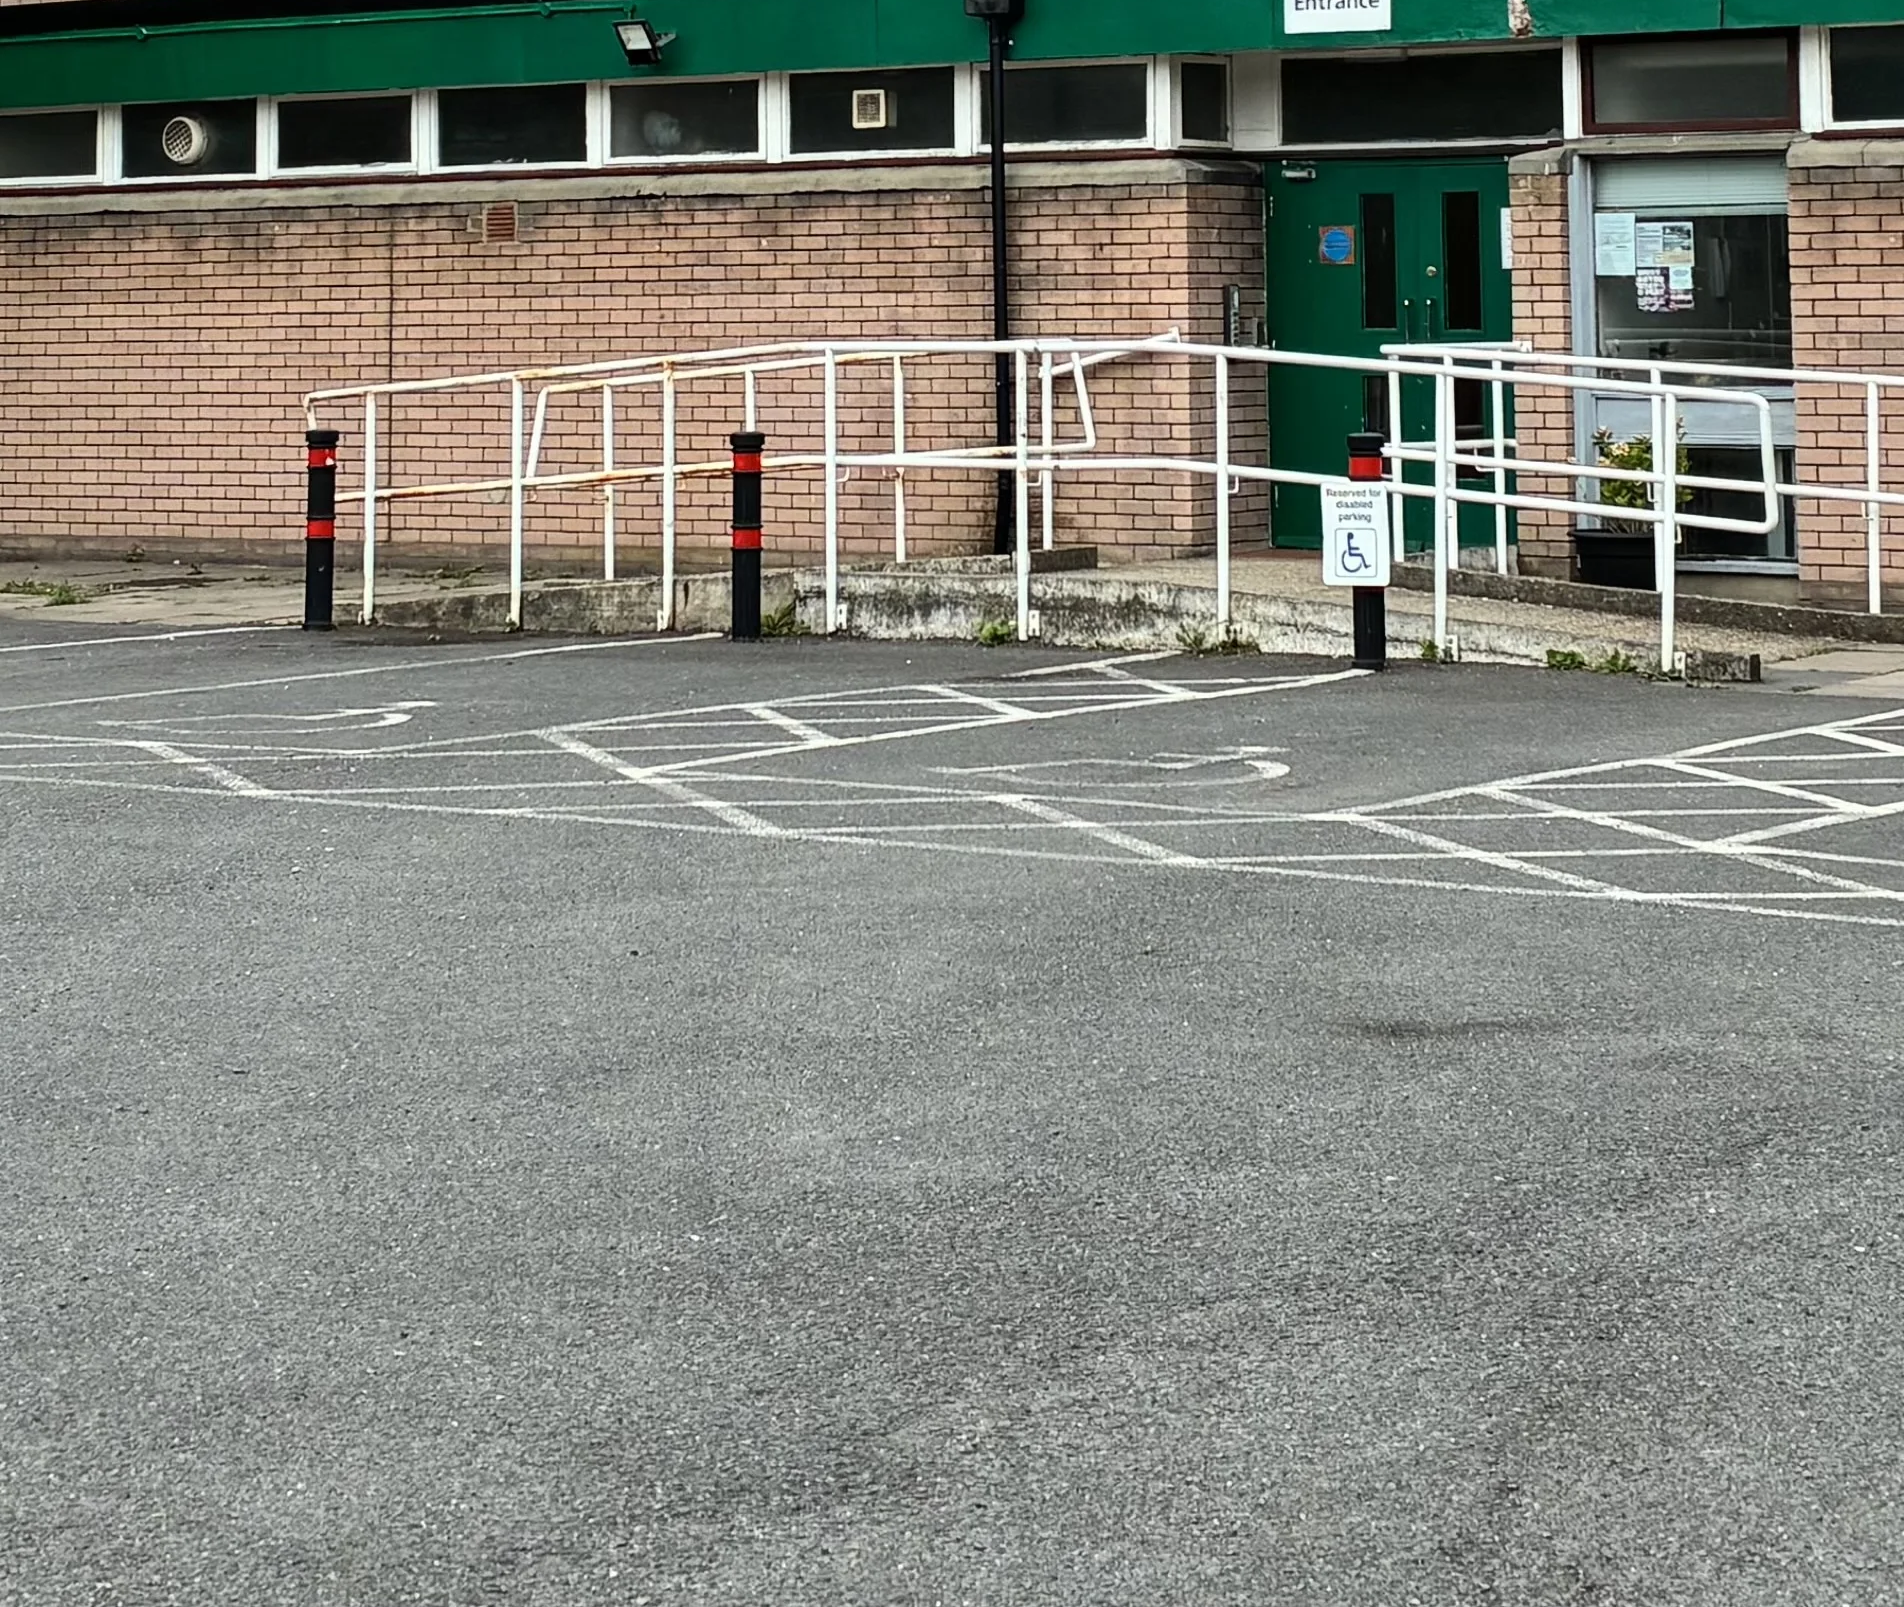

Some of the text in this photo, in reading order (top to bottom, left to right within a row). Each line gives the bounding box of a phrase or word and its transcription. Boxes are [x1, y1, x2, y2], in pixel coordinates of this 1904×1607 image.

[1326, 487, 1381, 497] Reserved for
[1336, 500, 1373, 509] disabled
[1338, 513, 1372, 523] parking
